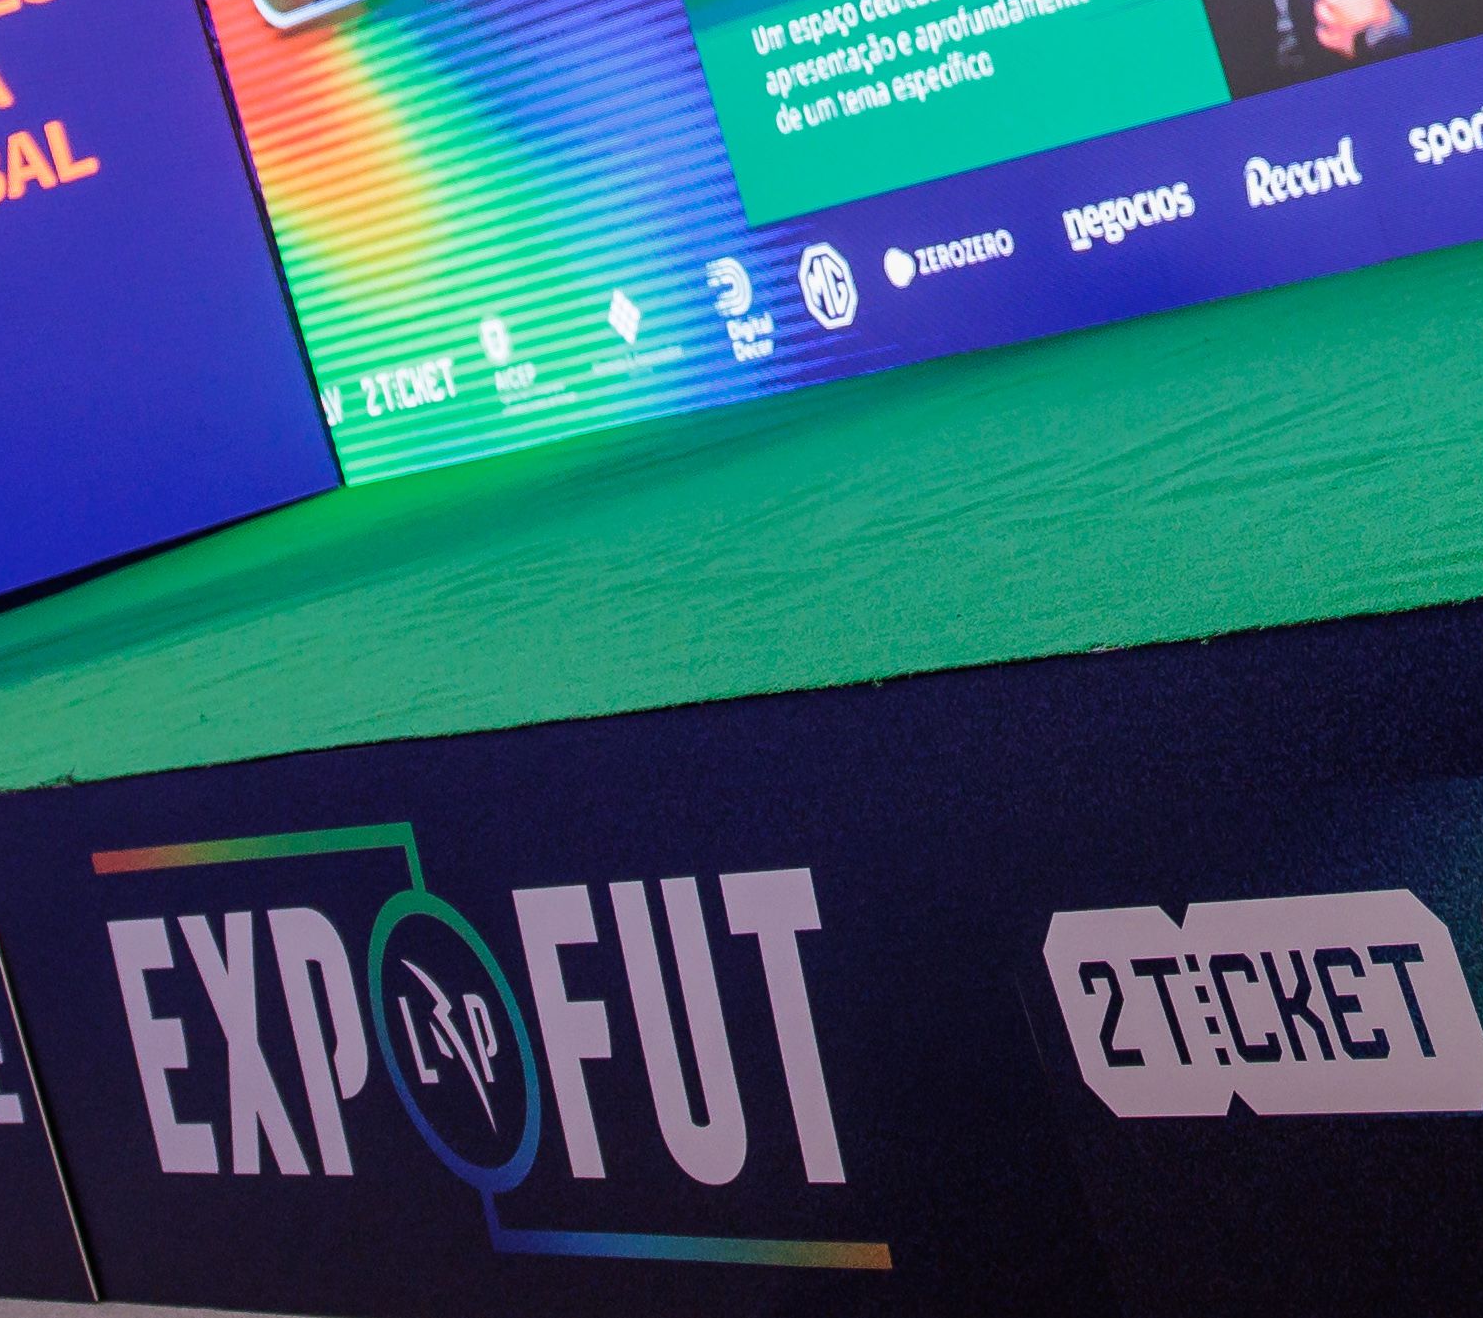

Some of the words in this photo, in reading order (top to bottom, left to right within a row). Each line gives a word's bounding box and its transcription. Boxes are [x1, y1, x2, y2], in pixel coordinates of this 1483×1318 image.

[751, 24, 787, 56] Um
[788, 2, 859, 45] espaço
[766, 33, 897, 99] apresentação
[896, 30, 914, 56] e
[776, 102, 803, 134] de
[802, 95, 839, 127] um
[836, 81, 892, 117] tema
[1244, 137, 1363, 208] Record
[1062, 181, 1196, 253] negocios
[914, 228, 1015, 276] ZEROZERO
[803, 251, 851, 324] MG
